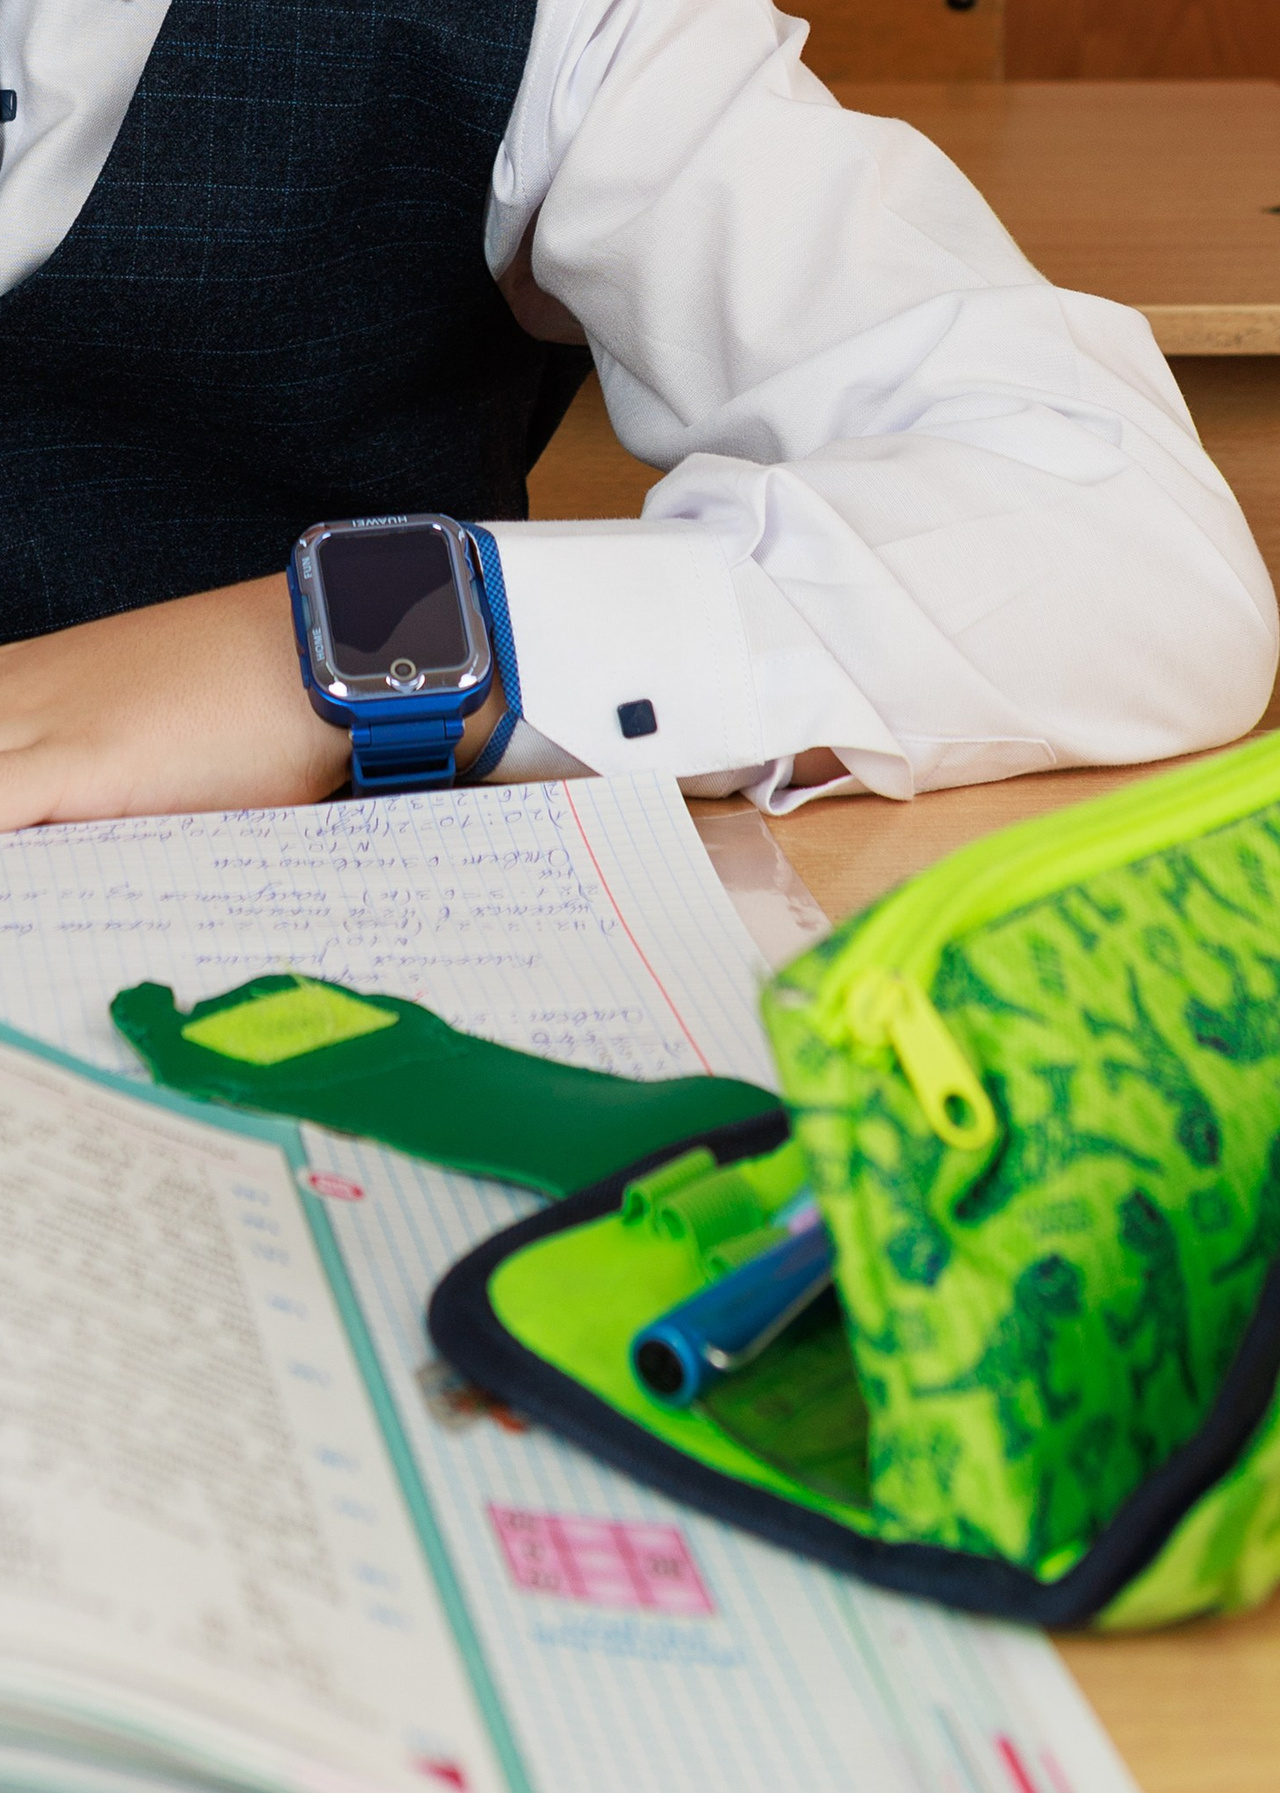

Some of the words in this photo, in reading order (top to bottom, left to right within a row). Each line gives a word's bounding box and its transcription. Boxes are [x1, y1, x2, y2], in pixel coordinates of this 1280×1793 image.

[351, 514, 408, 527] HUAWEI
[302, 556, 312, 580] FUN
[312, 627, 323, 662] HOME
[372, 954, 540, 970] Классная
